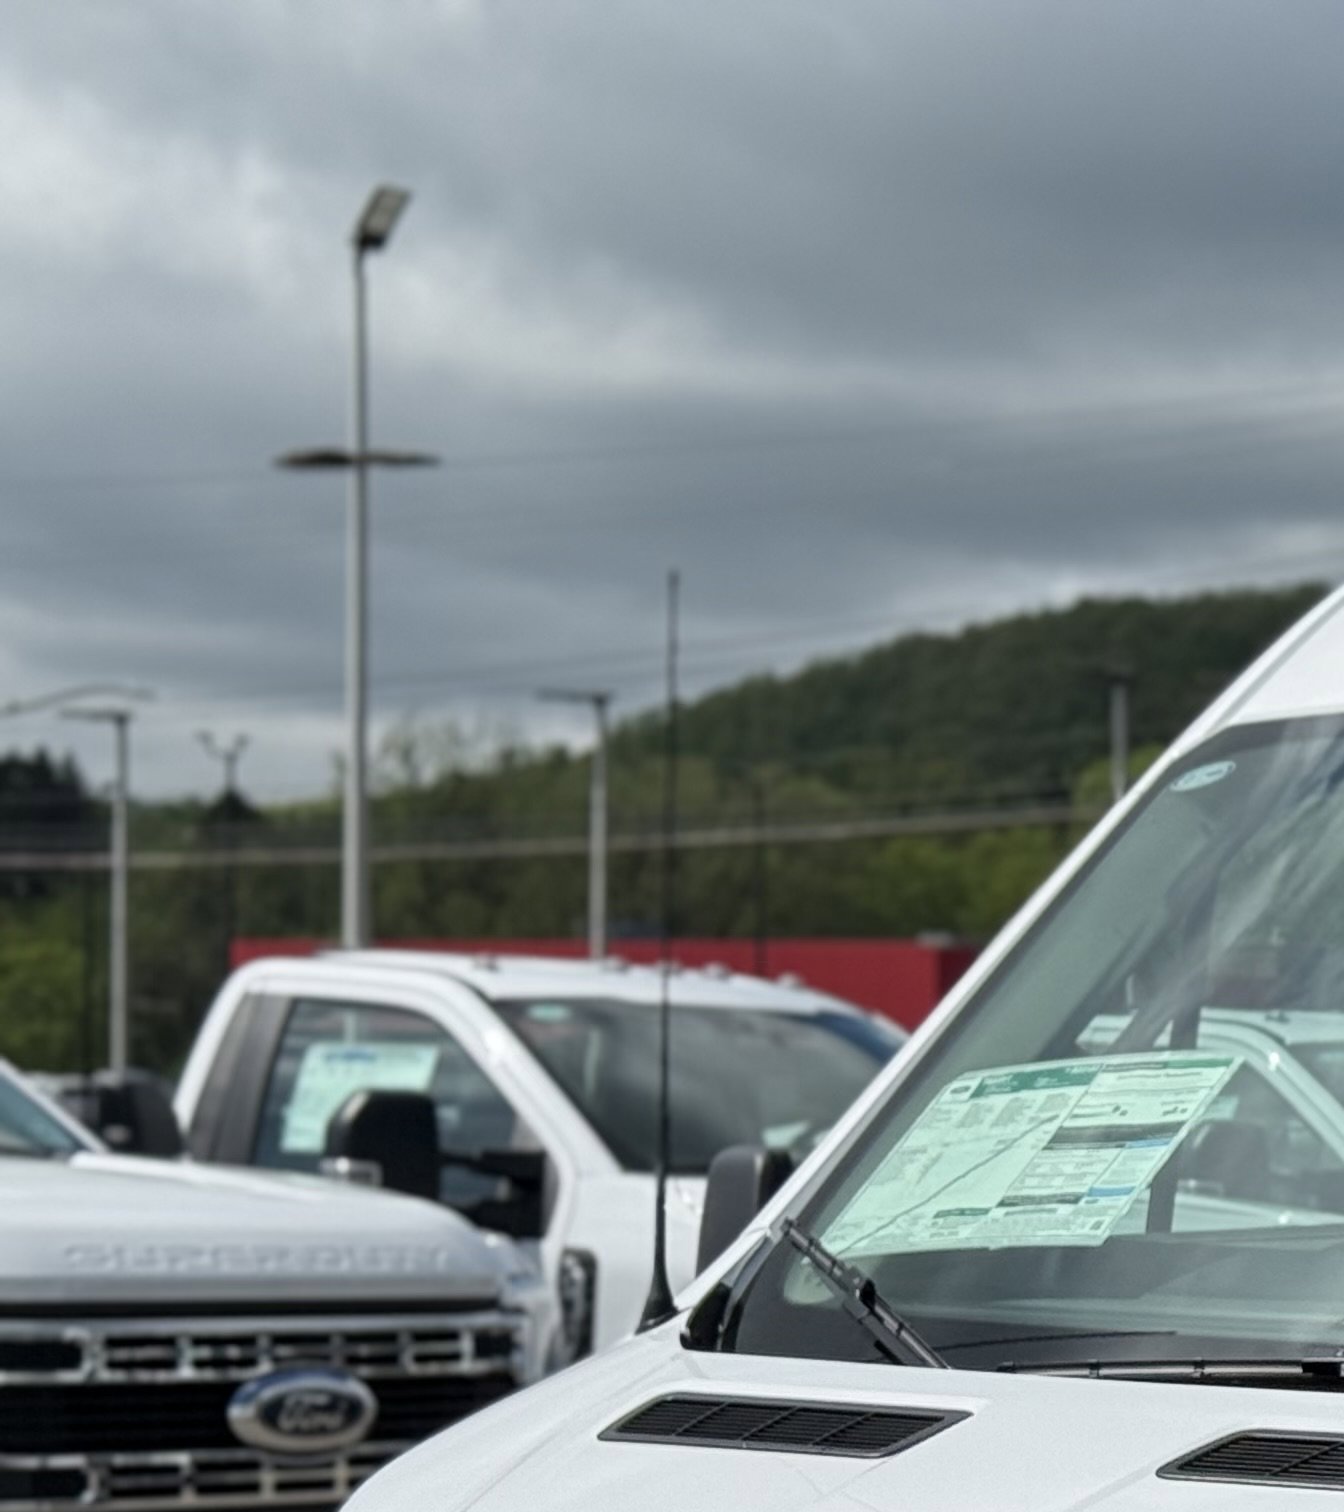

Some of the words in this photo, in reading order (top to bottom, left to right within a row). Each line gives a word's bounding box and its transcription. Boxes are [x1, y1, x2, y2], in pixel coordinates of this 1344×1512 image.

[64, 1242, 297, 1274] SUPER
[311, 1242, 450, 1273] DUTY
[277, 1393, 346, 1431] Ford
